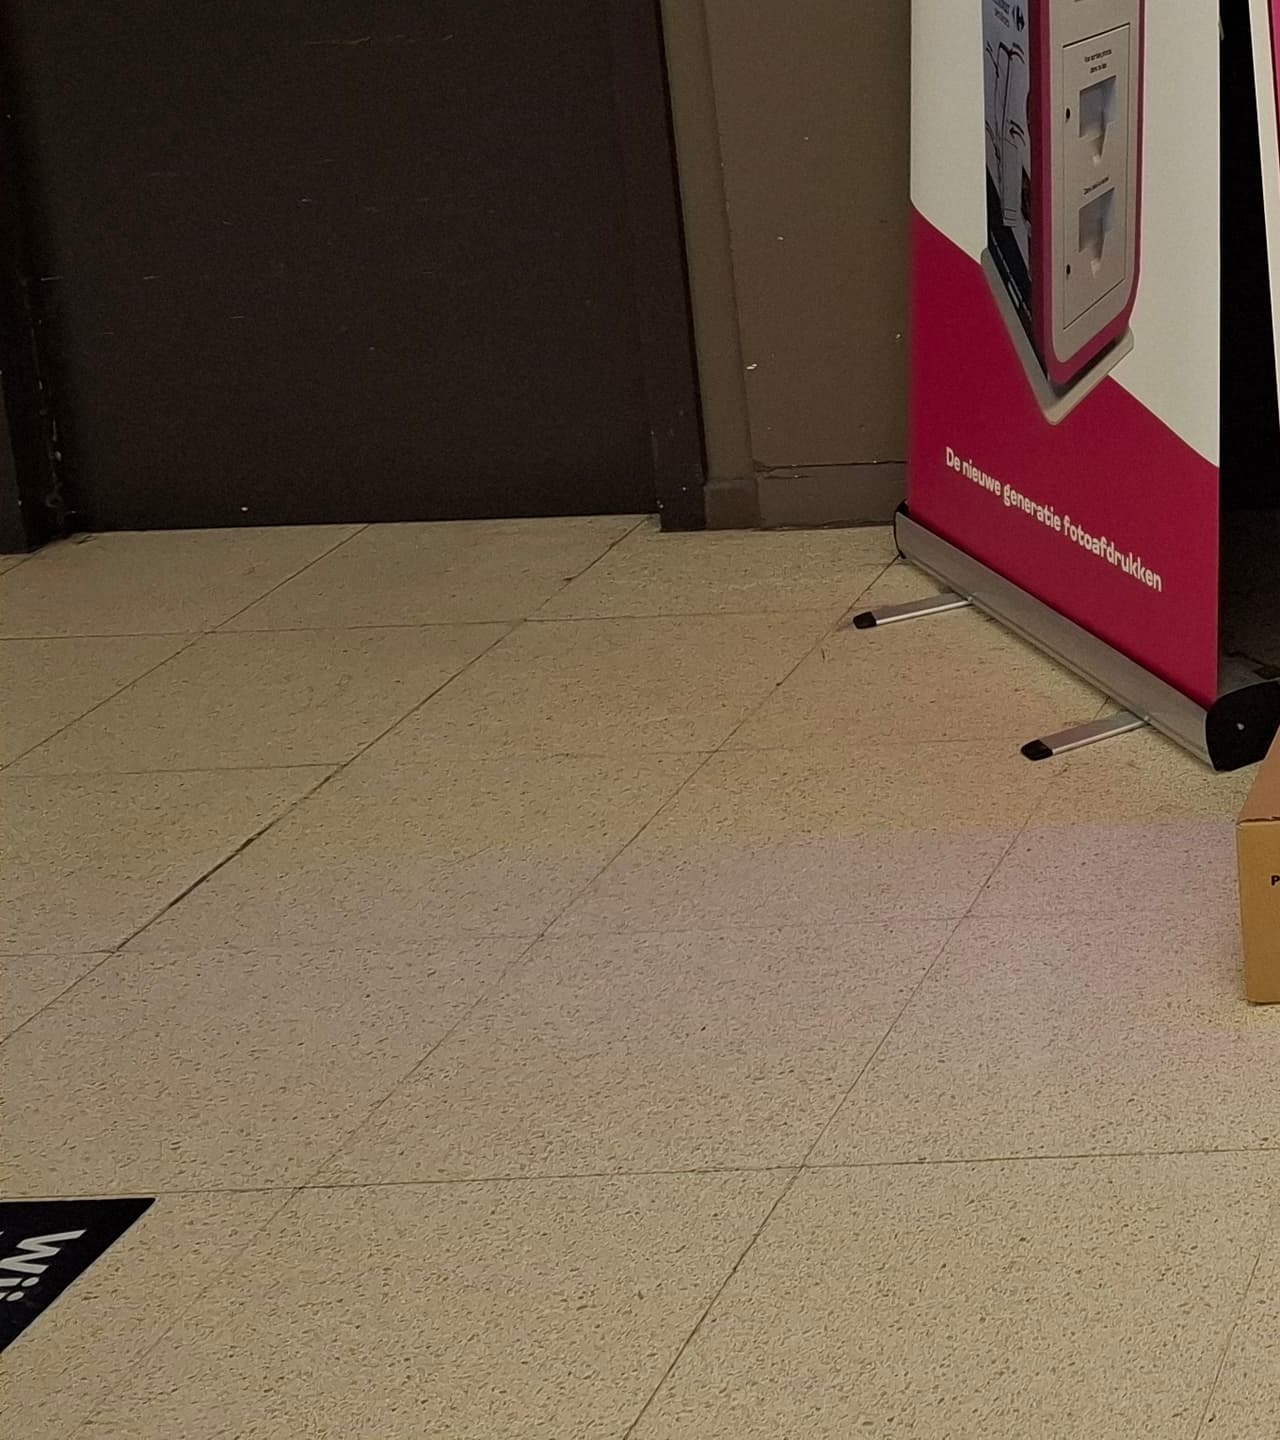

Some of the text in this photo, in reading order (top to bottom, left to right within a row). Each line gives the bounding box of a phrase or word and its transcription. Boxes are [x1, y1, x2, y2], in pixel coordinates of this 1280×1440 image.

[946, 446, 1162, 592] De nieuwe generatie fotoafdrukken
